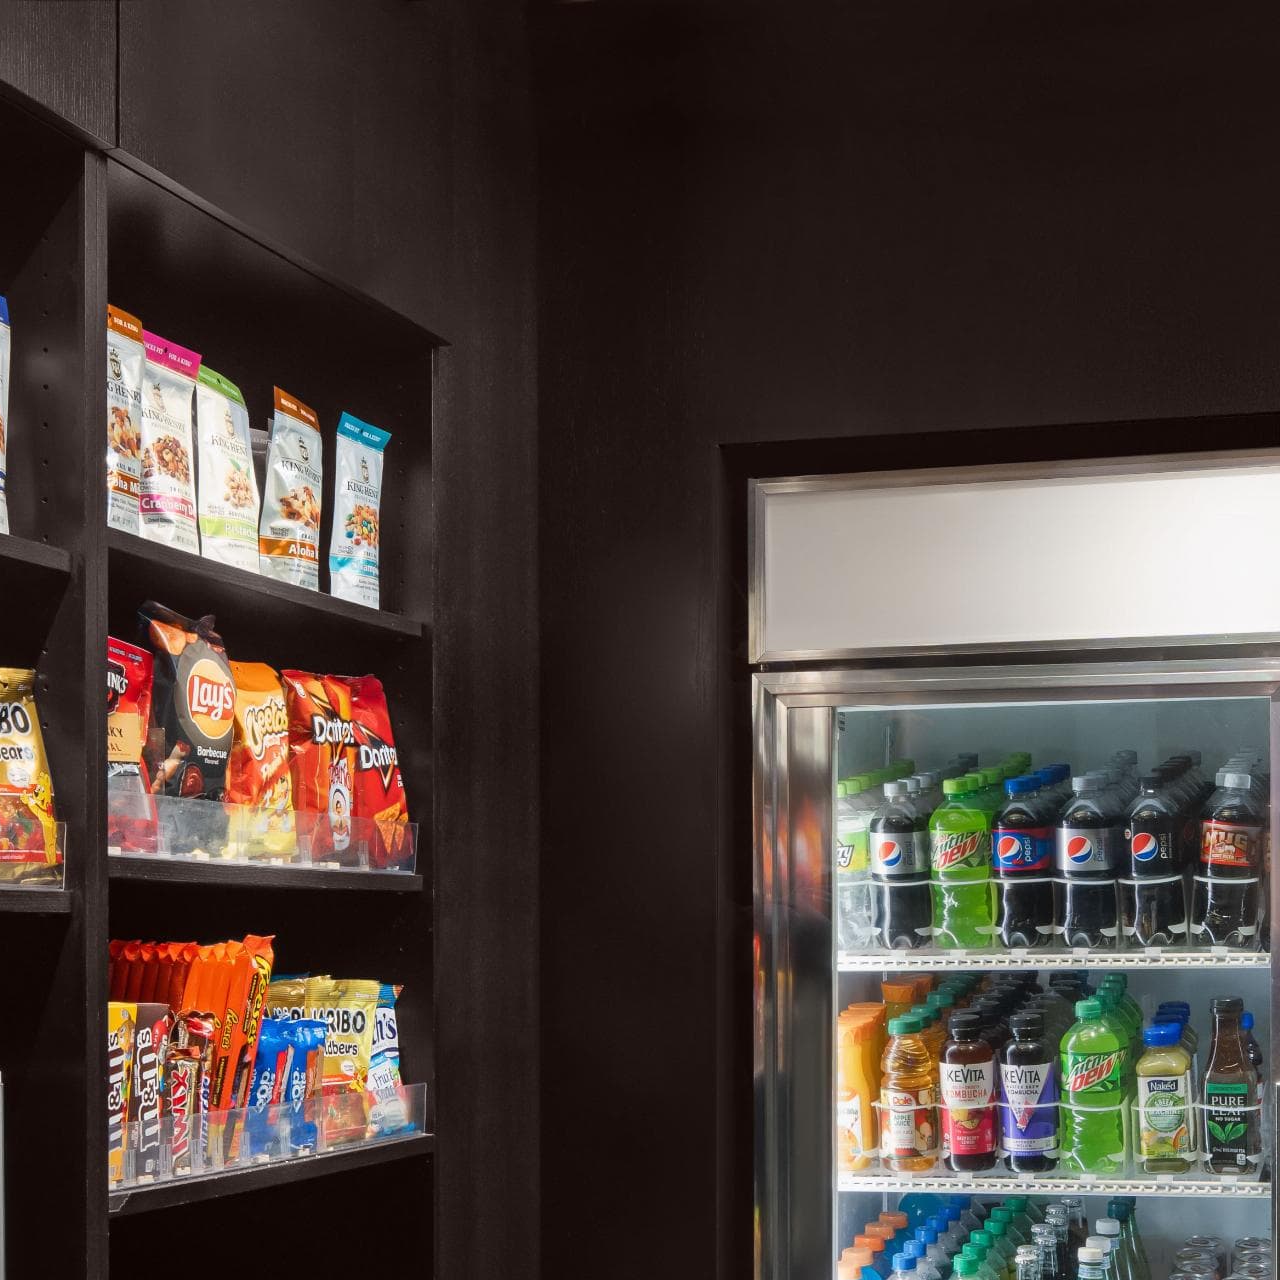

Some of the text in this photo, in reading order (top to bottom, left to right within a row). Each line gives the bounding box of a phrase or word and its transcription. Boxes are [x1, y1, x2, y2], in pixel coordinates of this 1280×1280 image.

[288, 542, 315, 558] Aloha
[191, 675, 234, 721] Lay's
[196, 745, 228, 759] Barbecue
[1160, 834, 1168, 859] pepsi
[1205, 831, 1249, 848] MUG
[1024, 837, 1033, 863] pepsi
[373, 1068, 394, 1086] Fruit
[1149, 1080, 1177, 1092] Naked
[1211, 1096, 1245, 1106] PURE
[171, 1069, 189, 1158] TWIX
